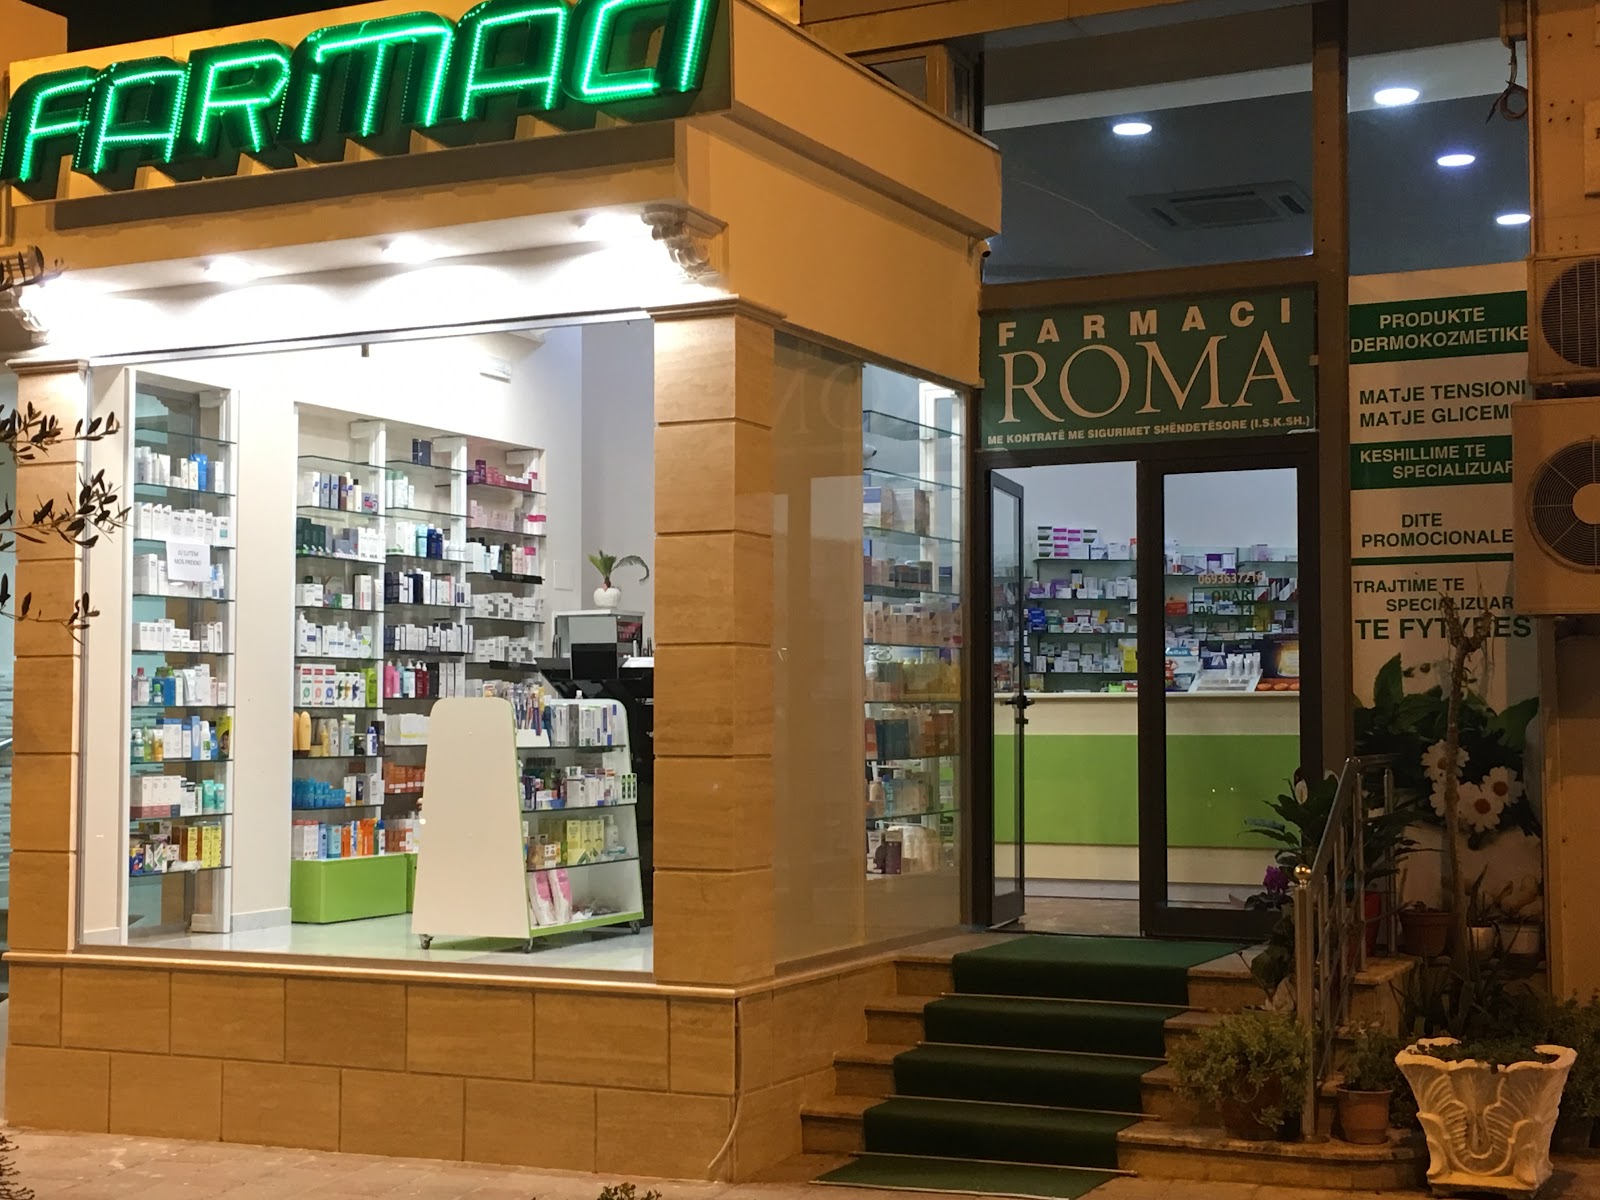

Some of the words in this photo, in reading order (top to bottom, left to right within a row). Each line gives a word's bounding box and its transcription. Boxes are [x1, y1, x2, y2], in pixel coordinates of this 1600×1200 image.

[998, 297, 1291, 347] FARMACI
[1379, 306, 1486, 330] PRODUKTE
[1350, 325, 1529, 354] DERMOKOZMETIKE
[998, 330, 1301, 425] ROMA
[1359, 386, 1425, 405] MATJE
[1430, 379, 1527, 402] TENSIONI
[1359, 408, 1425, 428] MATJE
[987, 434, 1004, 446] ME
[1006, 428, 1066, 444] KONTRATË
[1068, 429, 1085, 440] ME
[1087, 425, 1151, 440] SIGURIMET
[1153, 418, 1248, 436] SHËNDETËSORE
[1360, 444, 1460, 464] KESHILLIME
[1464, 443, 1487, 459] TE
[1401, 512, 1443, 529] DITE
[1361, 528, 1514, 549] PROMOCIONALE
[1353, 578, 1438, 594] TRAJTIME
[1442, 577, 1465, 592] TE
[1354, 618, 1390, 640] TE
